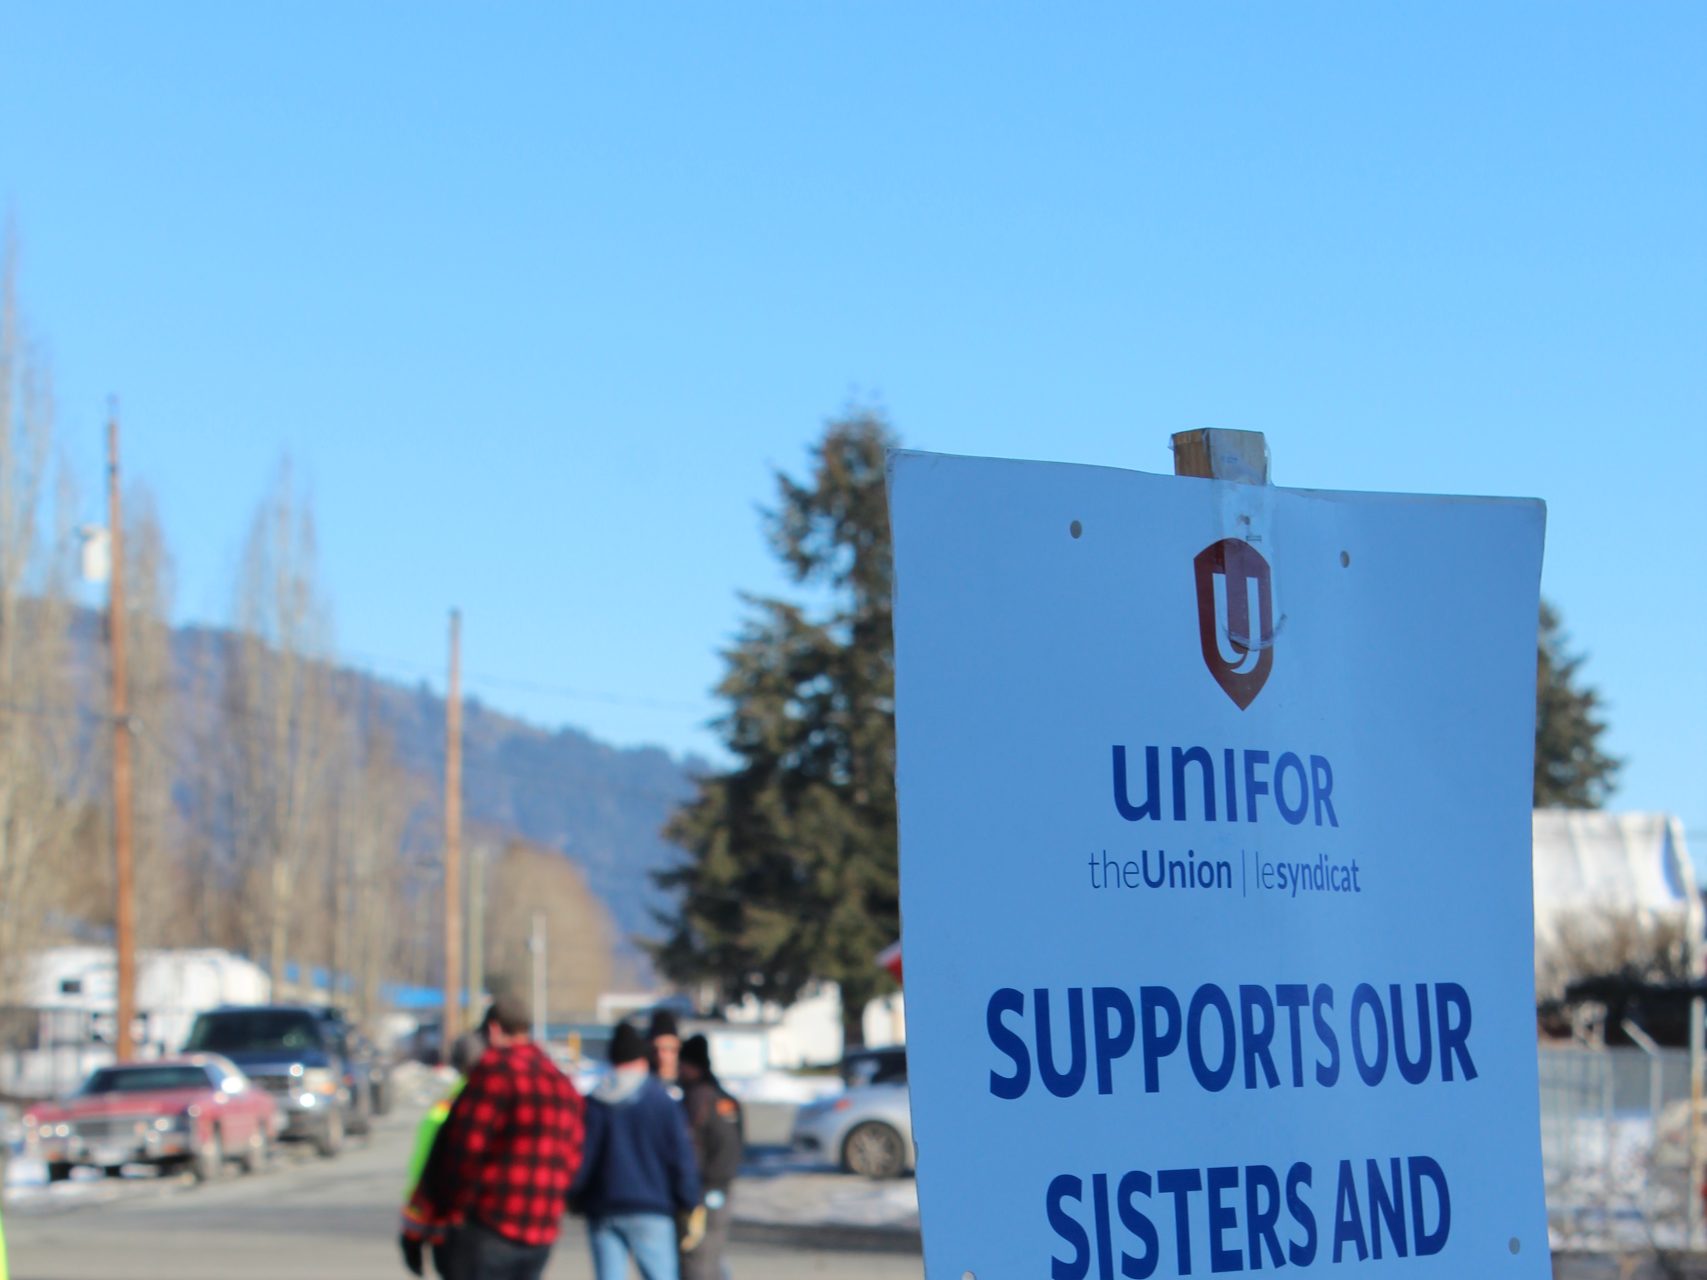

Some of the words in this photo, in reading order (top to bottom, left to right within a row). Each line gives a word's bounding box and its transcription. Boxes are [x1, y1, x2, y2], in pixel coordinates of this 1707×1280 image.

[986, 983, 1341, 1100] SUPPORTS
[1350, 982, 1478, 1087] OUR
[1332, 1155, 1451, 1264] AND
